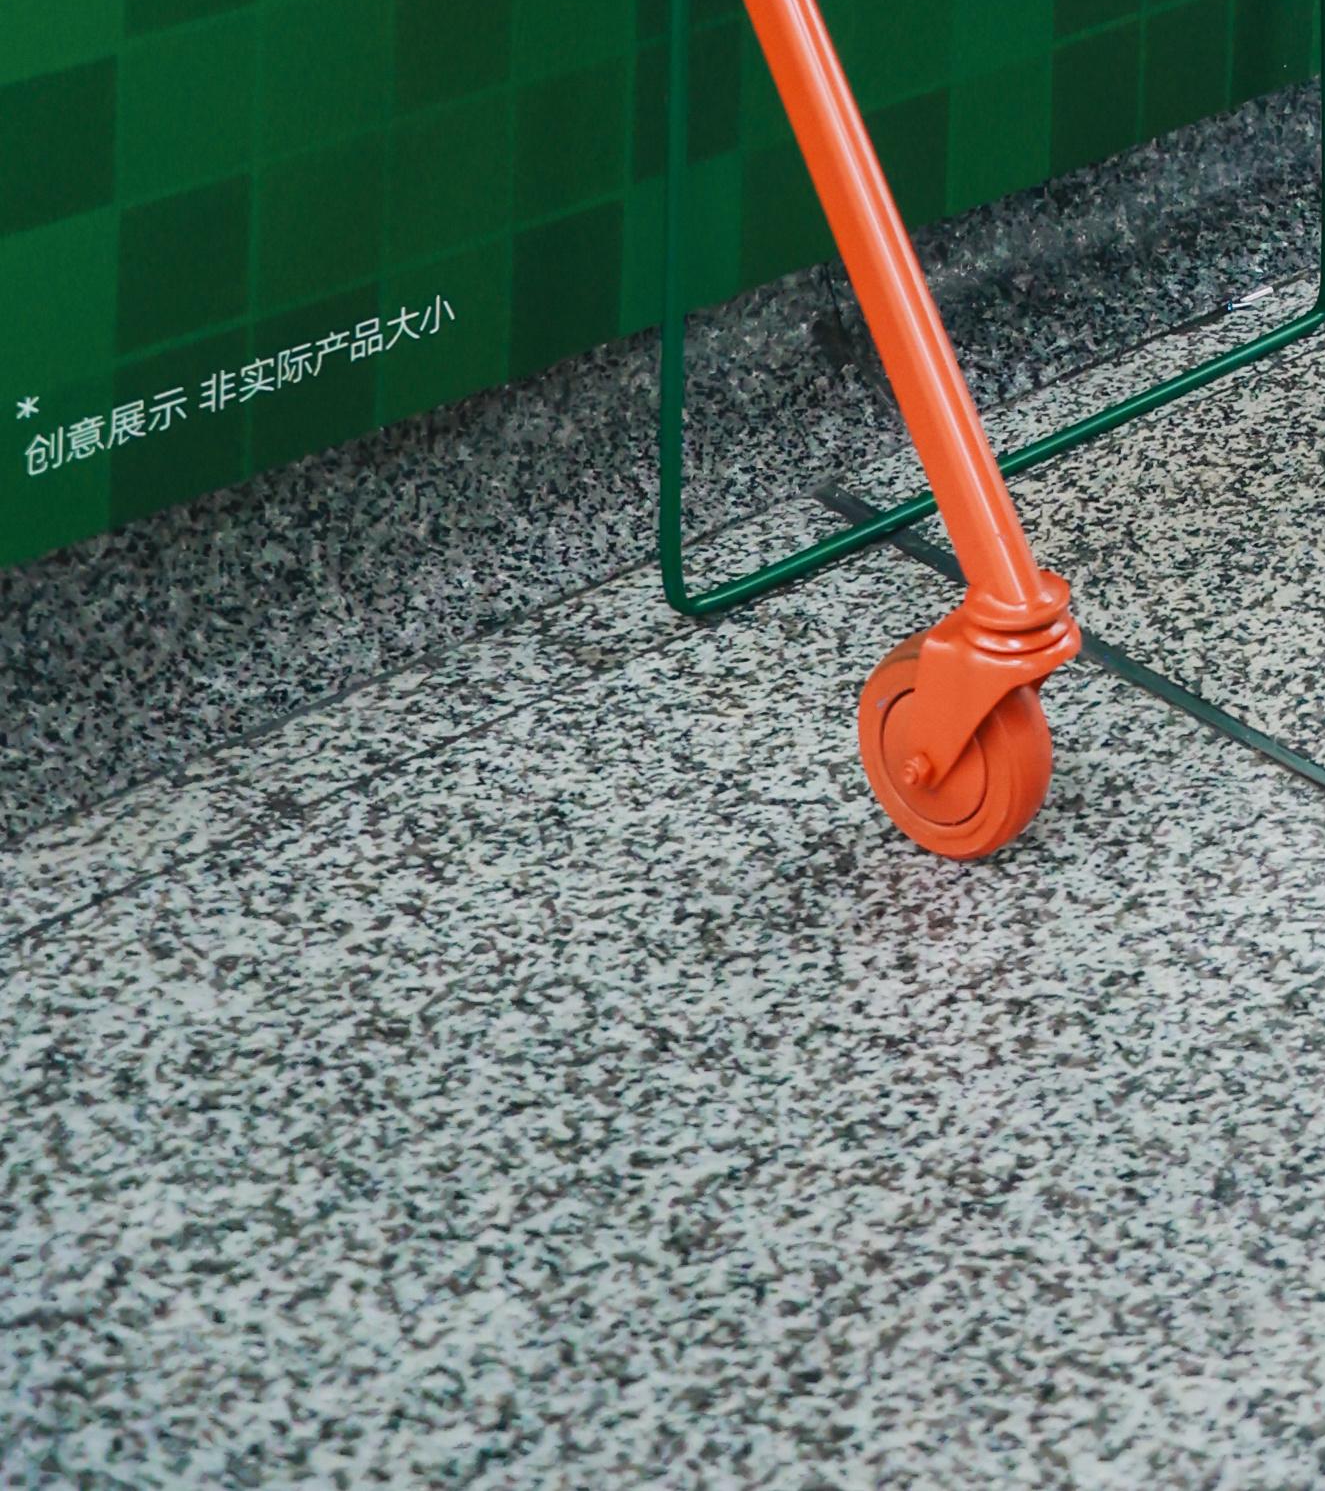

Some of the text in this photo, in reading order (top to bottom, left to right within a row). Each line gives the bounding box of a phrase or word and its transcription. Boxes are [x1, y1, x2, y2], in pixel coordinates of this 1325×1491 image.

[24, 295, 456, 476] 创意展示 非实际产品大小
